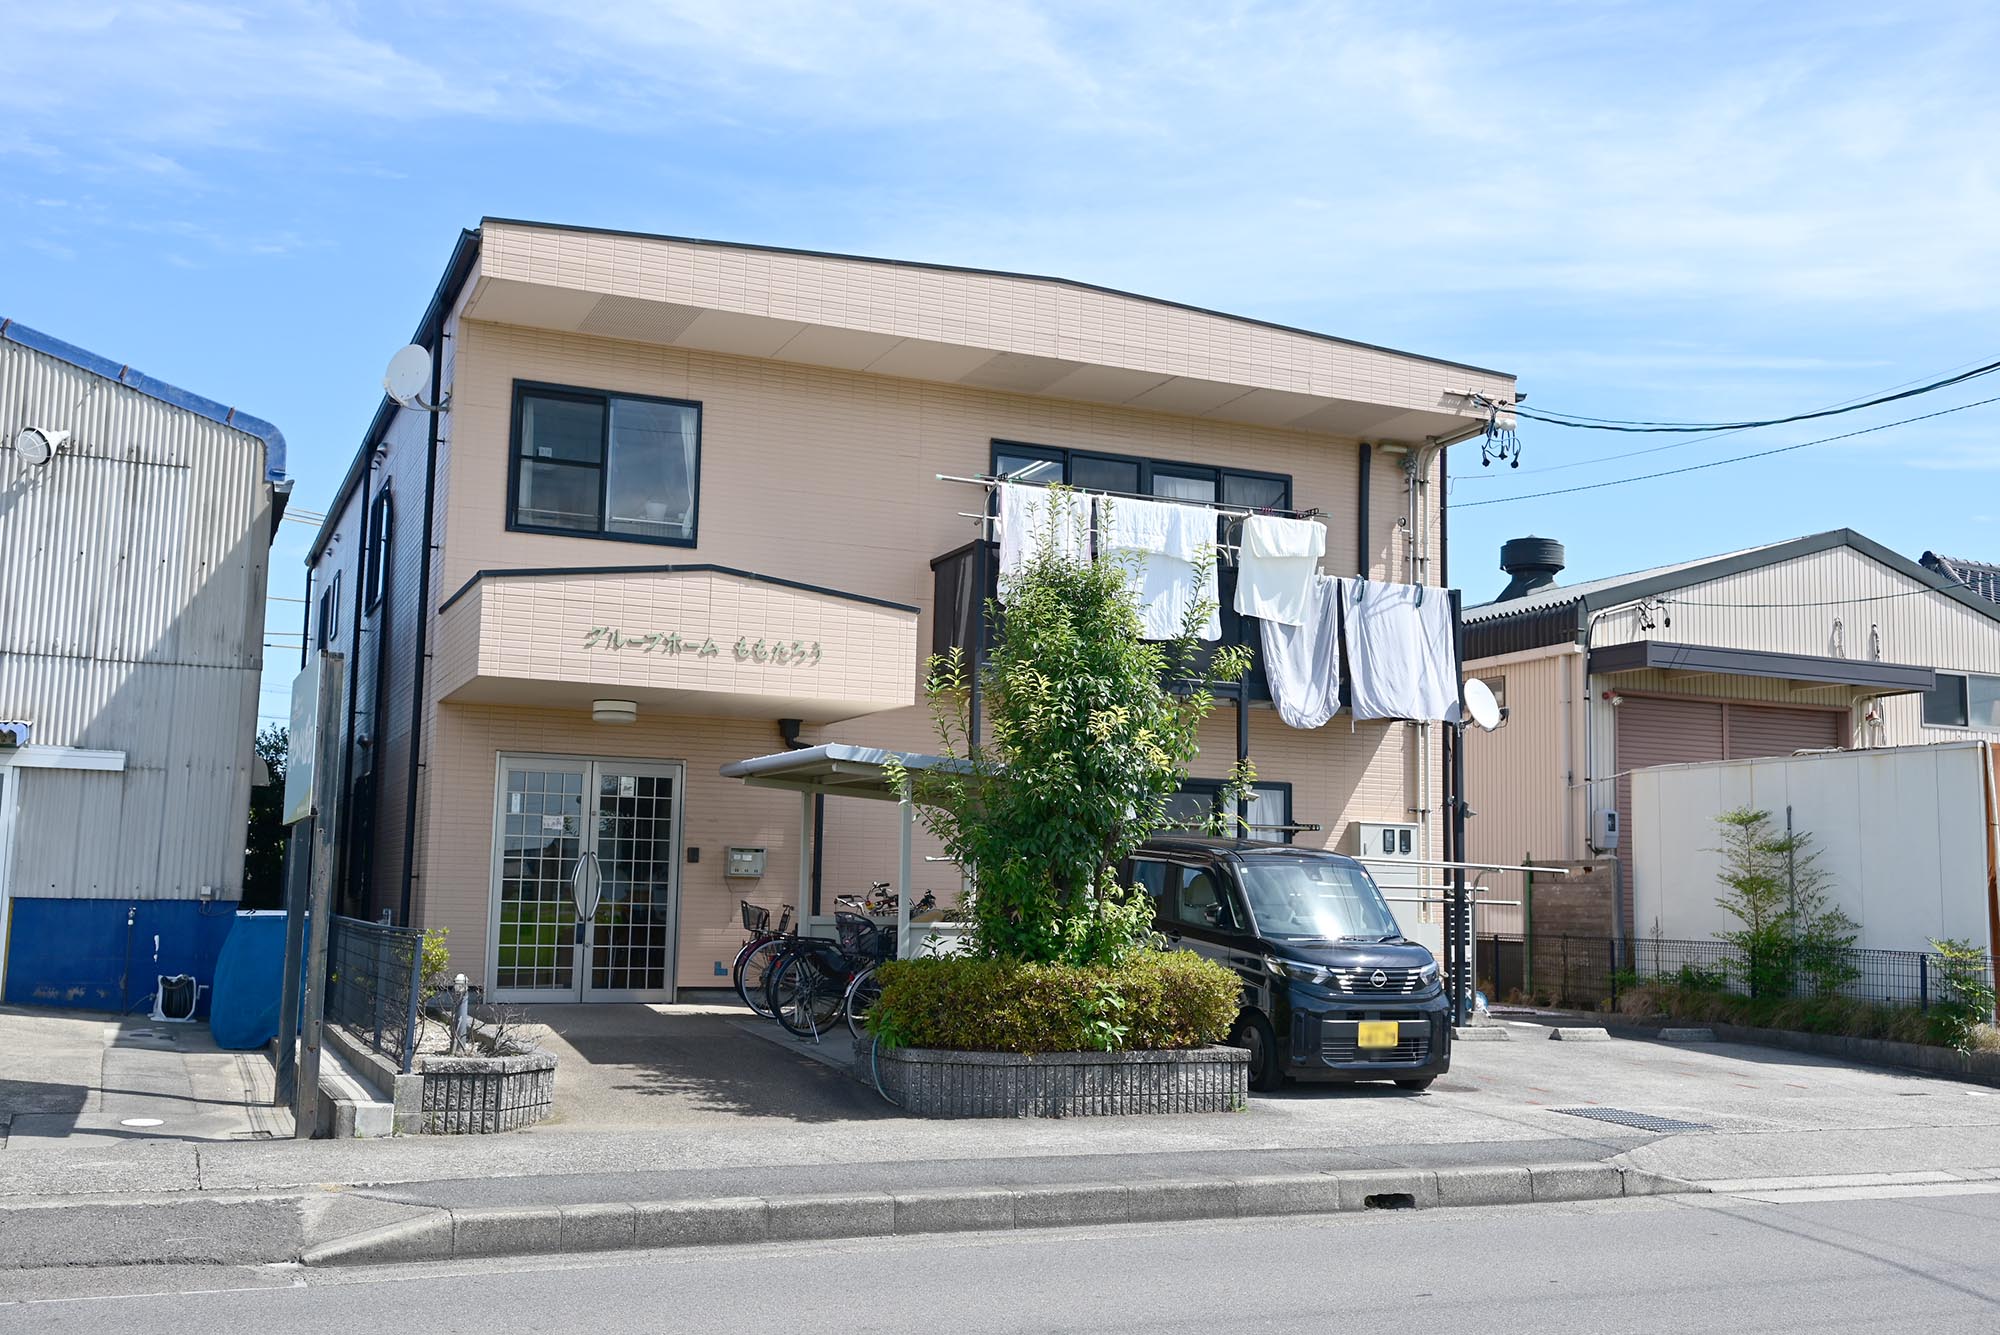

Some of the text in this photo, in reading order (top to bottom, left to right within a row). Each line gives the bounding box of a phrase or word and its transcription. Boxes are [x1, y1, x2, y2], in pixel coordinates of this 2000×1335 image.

[585, 626, 823, 665] グループホーム ももたろう
